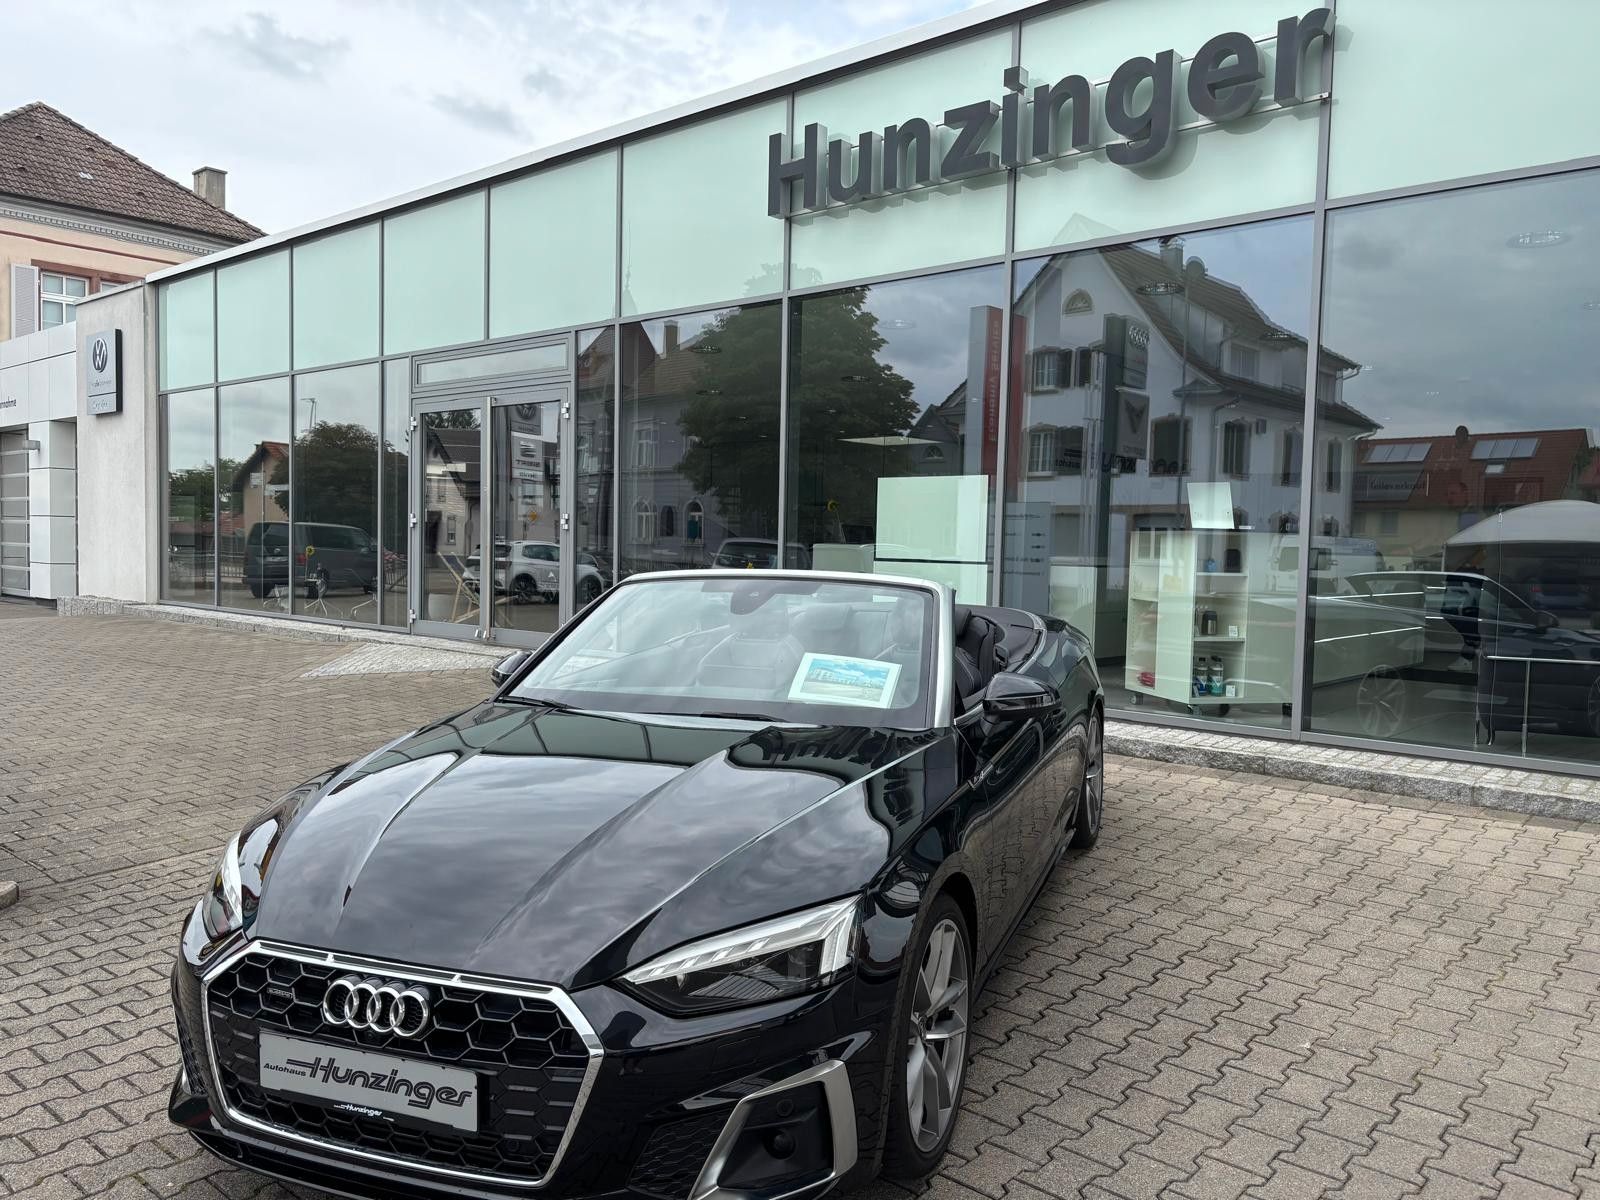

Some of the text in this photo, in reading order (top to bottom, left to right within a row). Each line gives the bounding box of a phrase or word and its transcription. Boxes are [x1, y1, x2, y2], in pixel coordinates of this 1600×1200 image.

[768, 7, 1334, 218] Hunzinger
[264, 1057, 473, 1109] Autohaus Hunzinger
[341, 1104, 383, 1117] Hunzinger
